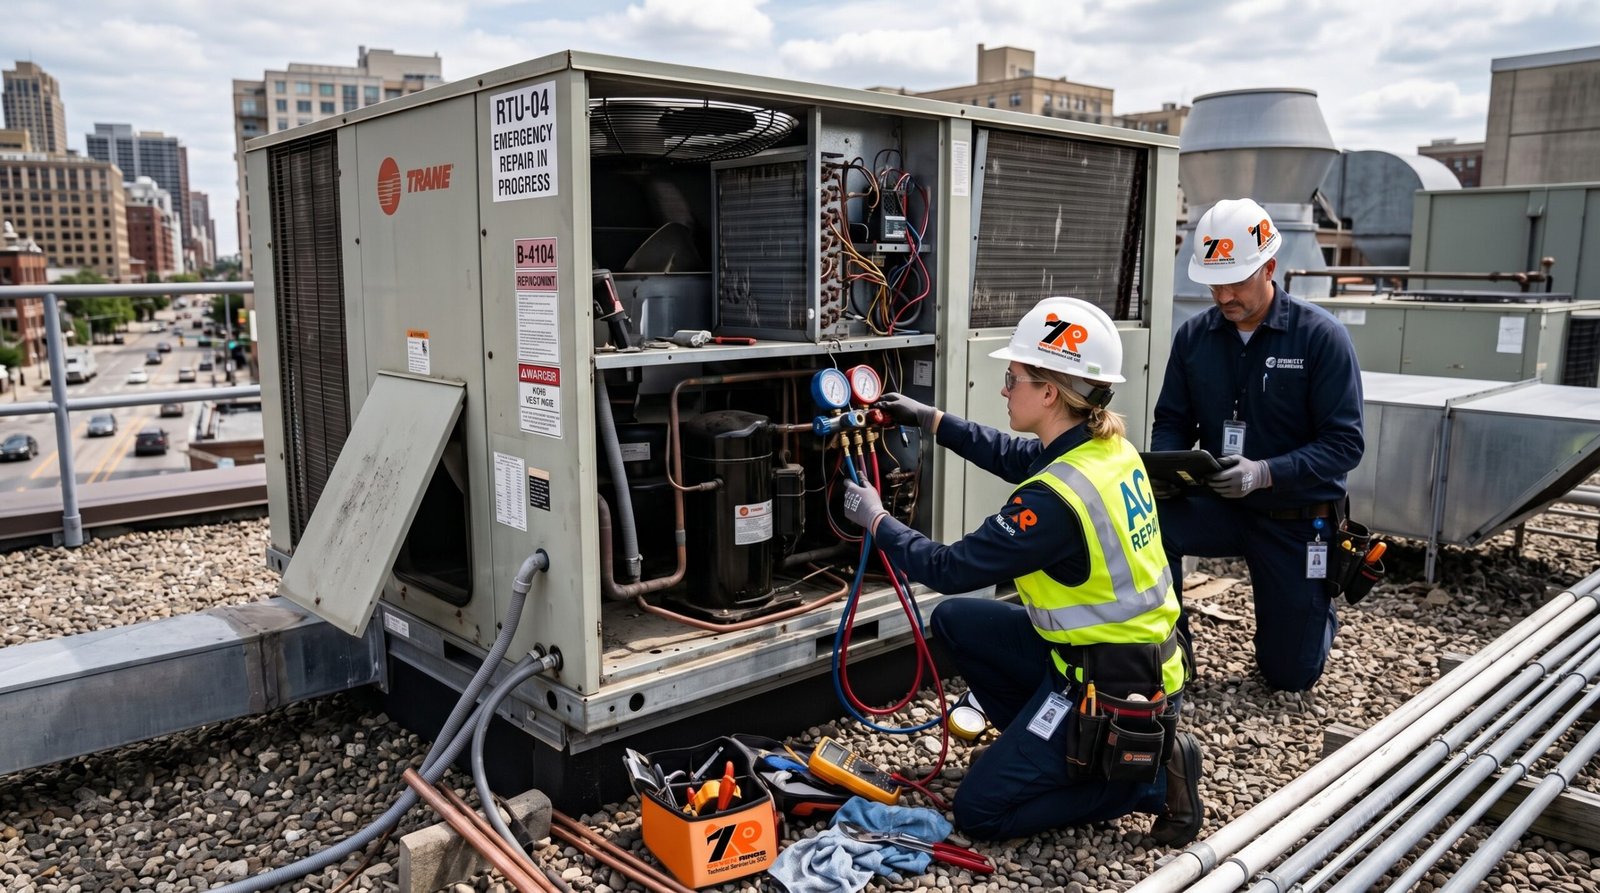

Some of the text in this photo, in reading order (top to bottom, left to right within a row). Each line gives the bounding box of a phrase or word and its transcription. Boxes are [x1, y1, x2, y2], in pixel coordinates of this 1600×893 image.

[496, 88, 549, 125] RTU-04
[494, 123, 553, 151] EMERGENCY
[500, 149, 548, 173] REPAIR IN
[406, 163, 452, 193] TRANE
[498, 173, 550, 197] PROGRESS
[517, 243, 555, 264] B-4104
[1120, 468, 1153, 532] AC
